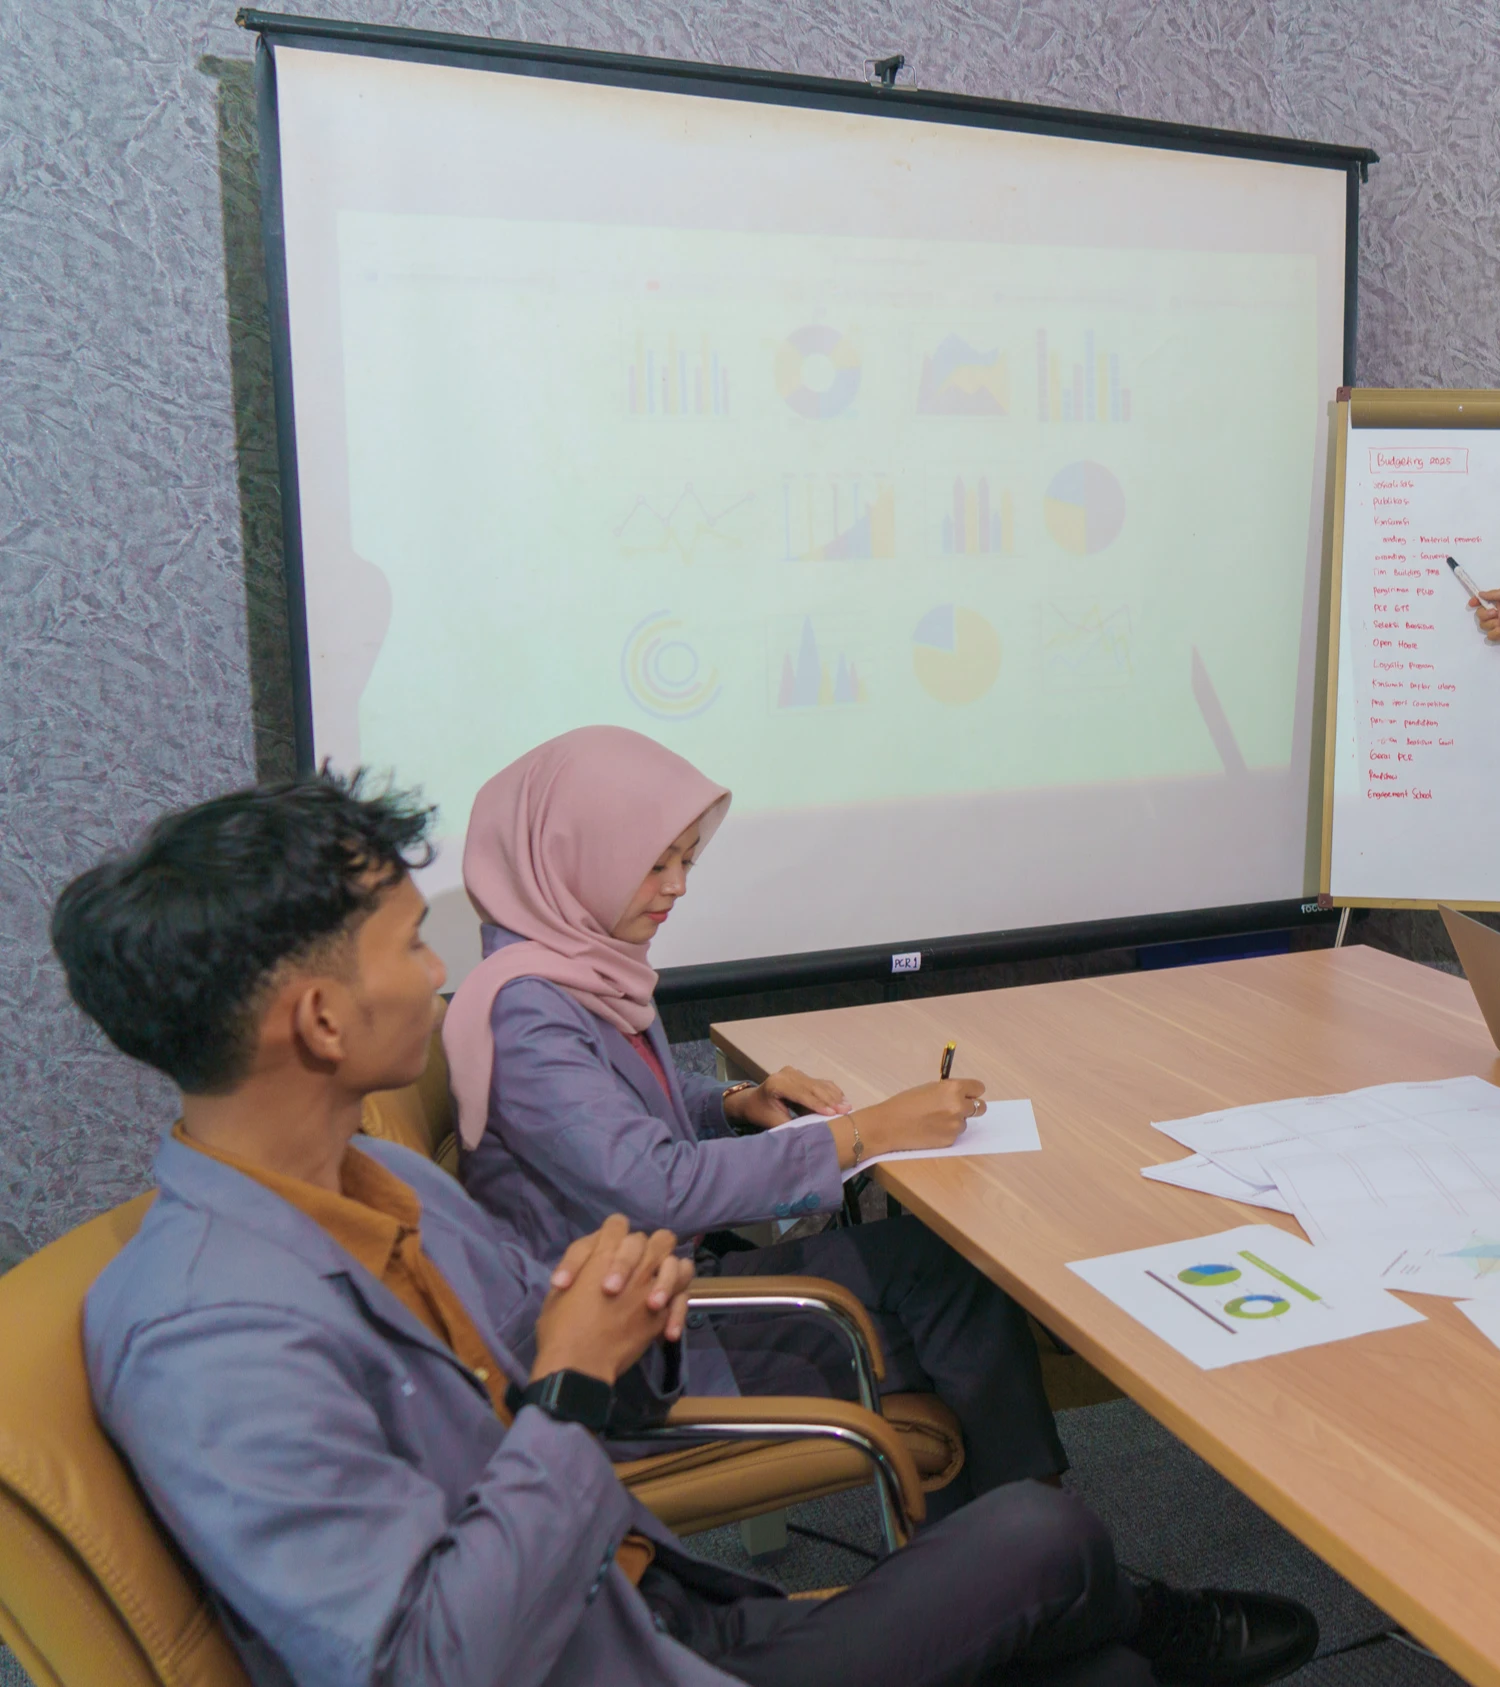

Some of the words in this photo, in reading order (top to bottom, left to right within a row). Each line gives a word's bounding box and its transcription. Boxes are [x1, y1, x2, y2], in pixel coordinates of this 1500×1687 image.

[1377, 452, 1423, 469] Budgeting
[1429, 457, 1452, 465] 2025
[1372, 638, 1392, 648] Open
[894, 957, 911, 968] PCR
[913, 956, 917, 969] 1
